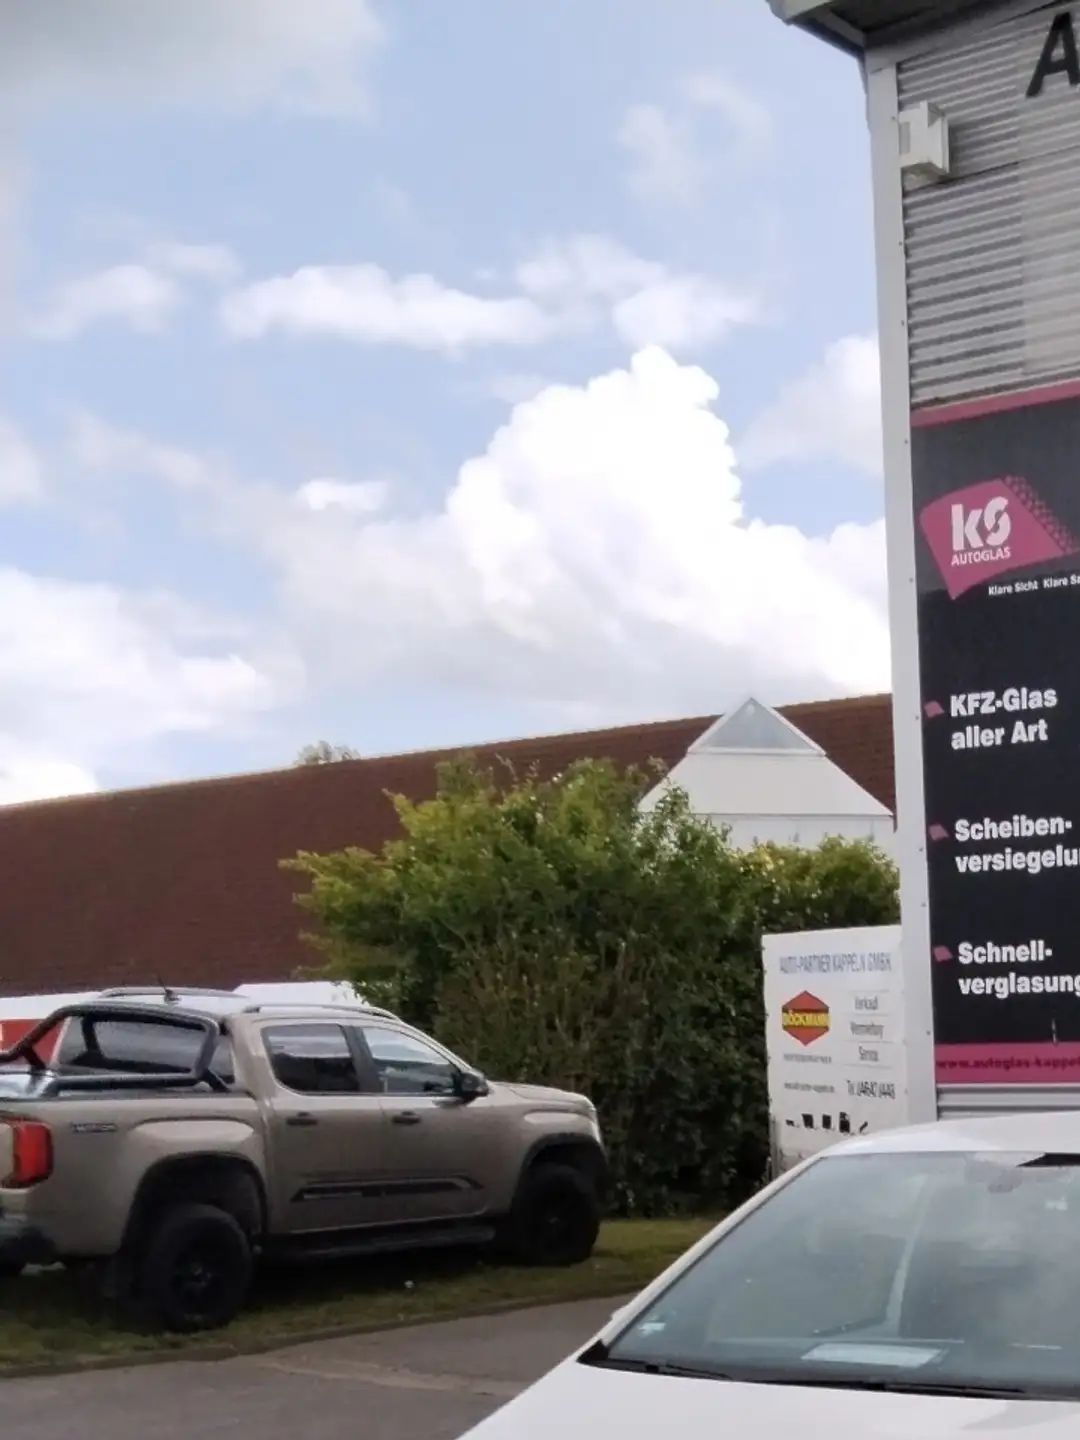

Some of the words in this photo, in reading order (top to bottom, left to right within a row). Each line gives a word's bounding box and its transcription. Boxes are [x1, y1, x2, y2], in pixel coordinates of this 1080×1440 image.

[951, 546, 1011, 567] AUTOGLAS
[988, 583, 1014, 596] Klare
[1014, 580, 1038, 593] Sicht
[1043, 576, 1068, 589] Klare
[951, 686, 1058, 717] KFZ-Glas
[951, 723, 1005, 750] aller
[1011, 719, 1048, 746] Art
[955, 815, 1073, 843] Scheiben-
[958, 940, 1053, 965] Schnell-
